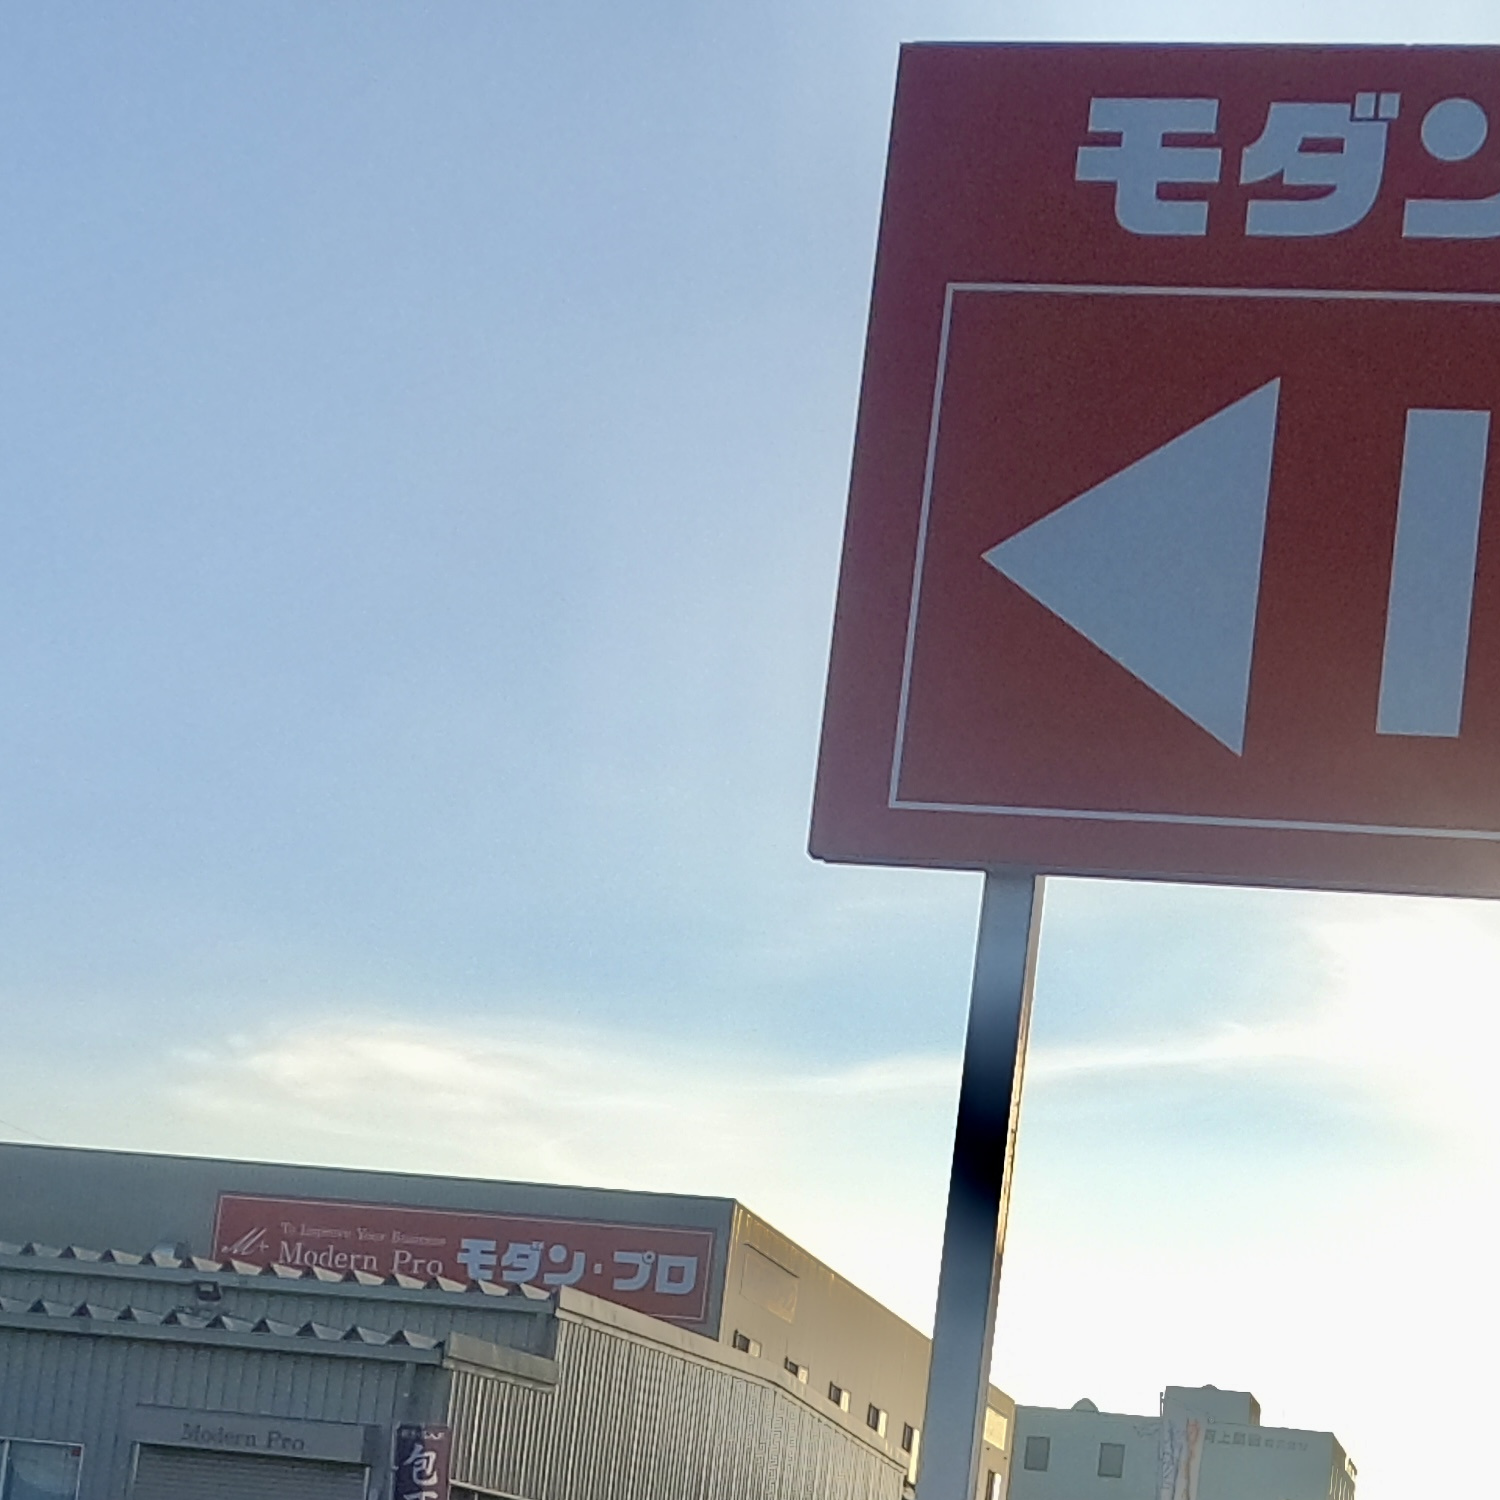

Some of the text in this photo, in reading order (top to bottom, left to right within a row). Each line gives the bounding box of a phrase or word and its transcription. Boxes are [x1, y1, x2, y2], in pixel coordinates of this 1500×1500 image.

[279, 1241, 444, 1276] Modern Pro
[457, 1238, 698, 1294] モダン・プロ
[266, 1430, 305, 1451] Pro
